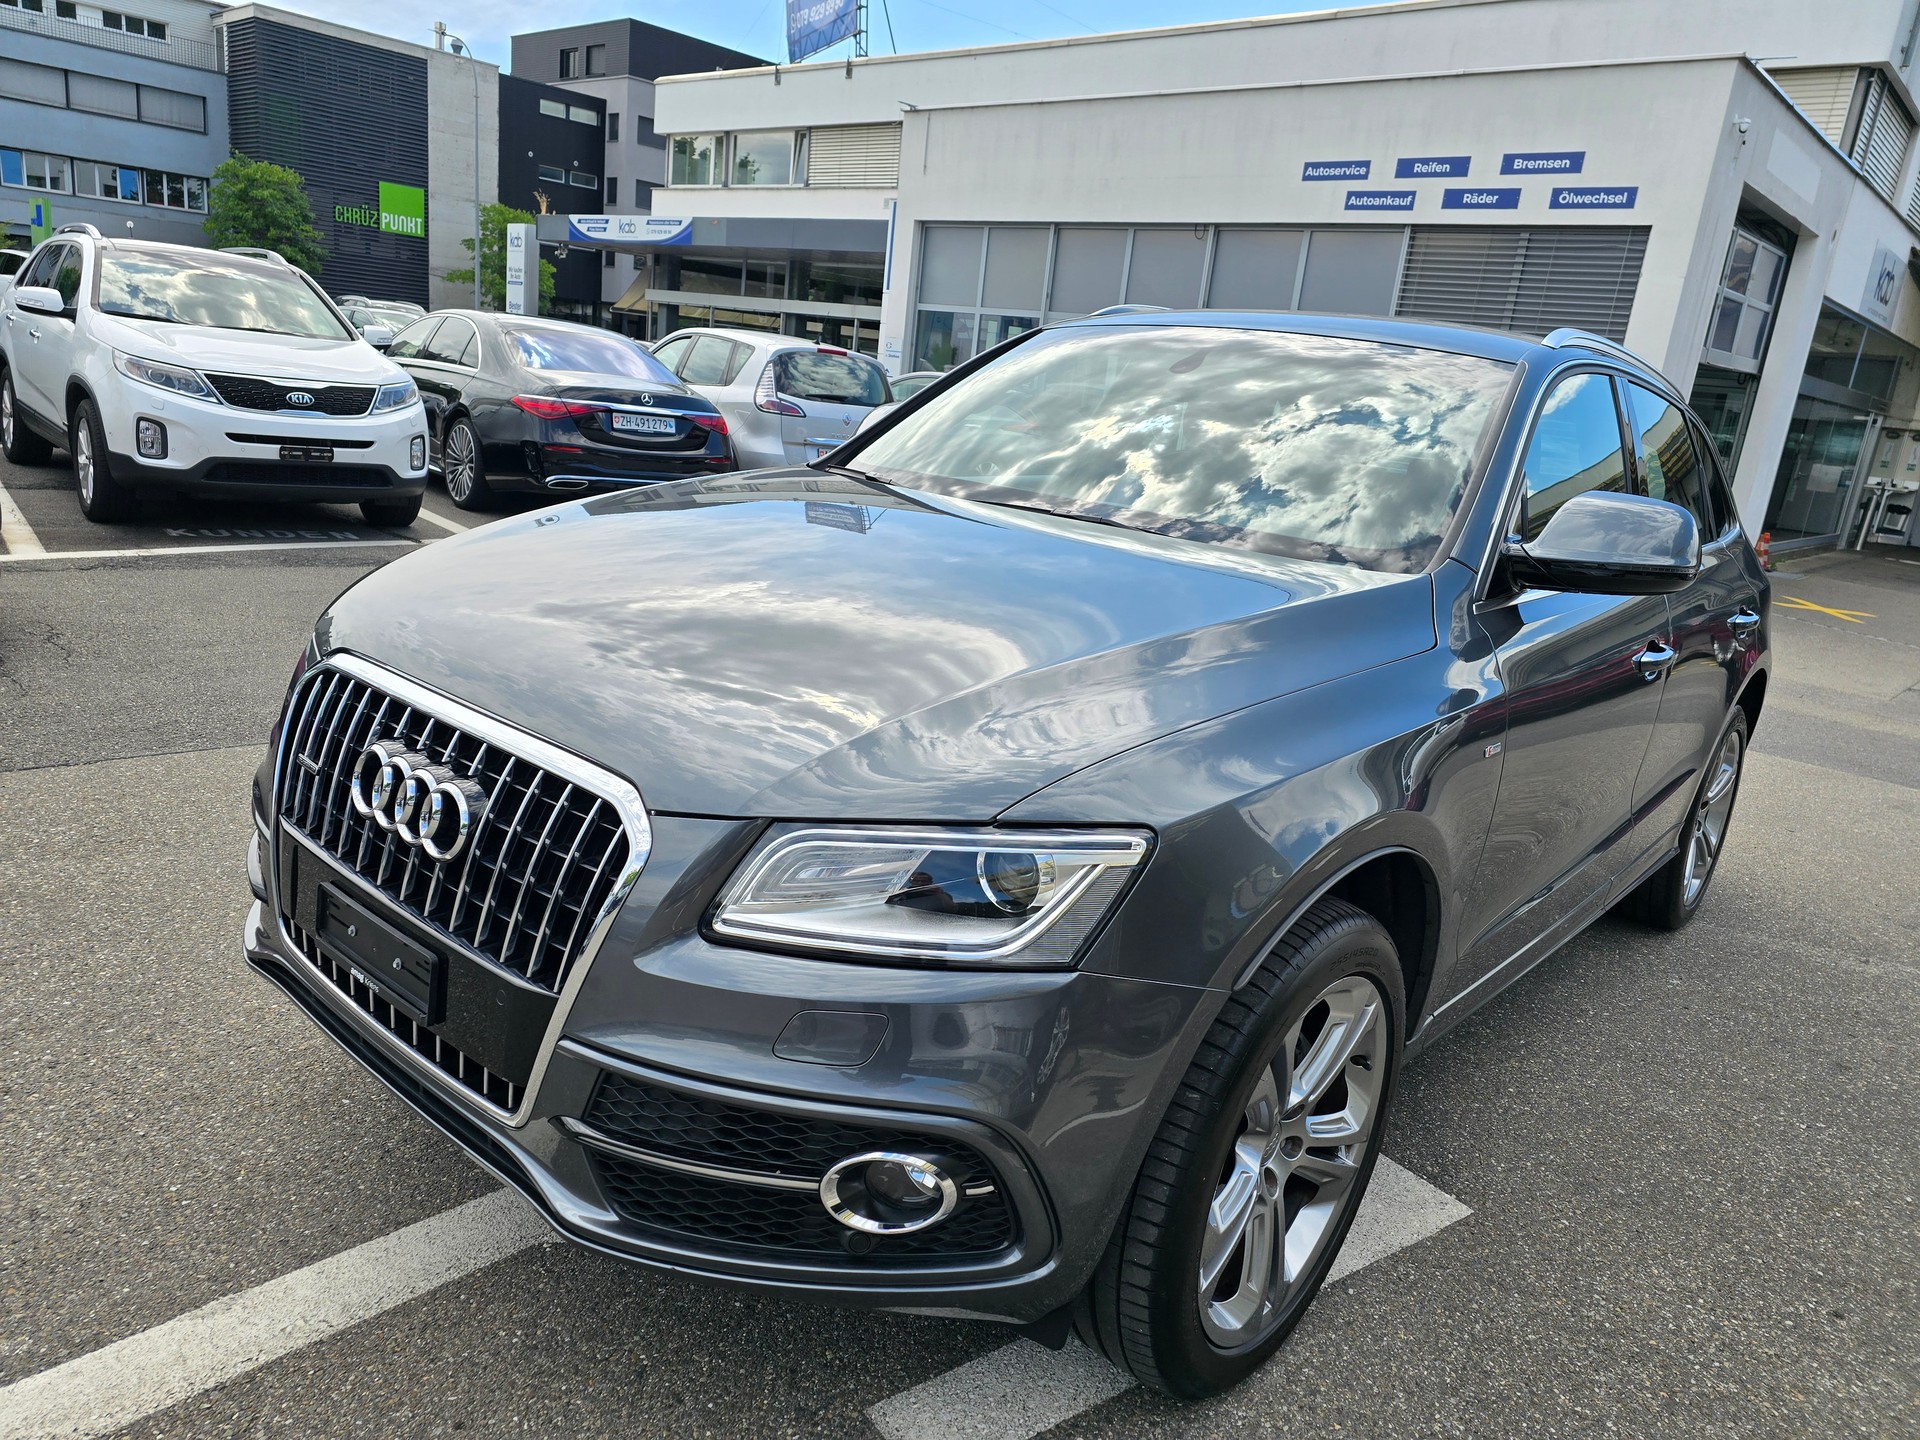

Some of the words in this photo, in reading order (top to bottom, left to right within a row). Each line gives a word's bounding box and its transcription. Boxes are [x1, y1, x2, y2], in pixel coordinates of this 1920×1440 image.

[797, 9, 809, 28] 079
[809, 2, 825, 22] 929
[1305, 164, 1367, 177] Autoservice
[1413, 161, 1451, 174] Reifen
[1513, 157, 1570, 170] Bremsen
[1348, 193, 1413, 207] Autoankauf
[1462, 192, 1499, 206] Räder
[1558, 190, 1628, 205] Ölwechsel
[335, 204, 378, 228] CHRÜZ
[382, 212, 423, 235] PUNKT
[618, 218, 637, 234] kab
[509, 232, 523, 248] kab
[291, 394, 311, 403] KIA
[162, 528, 360, 540] KUNDEN
